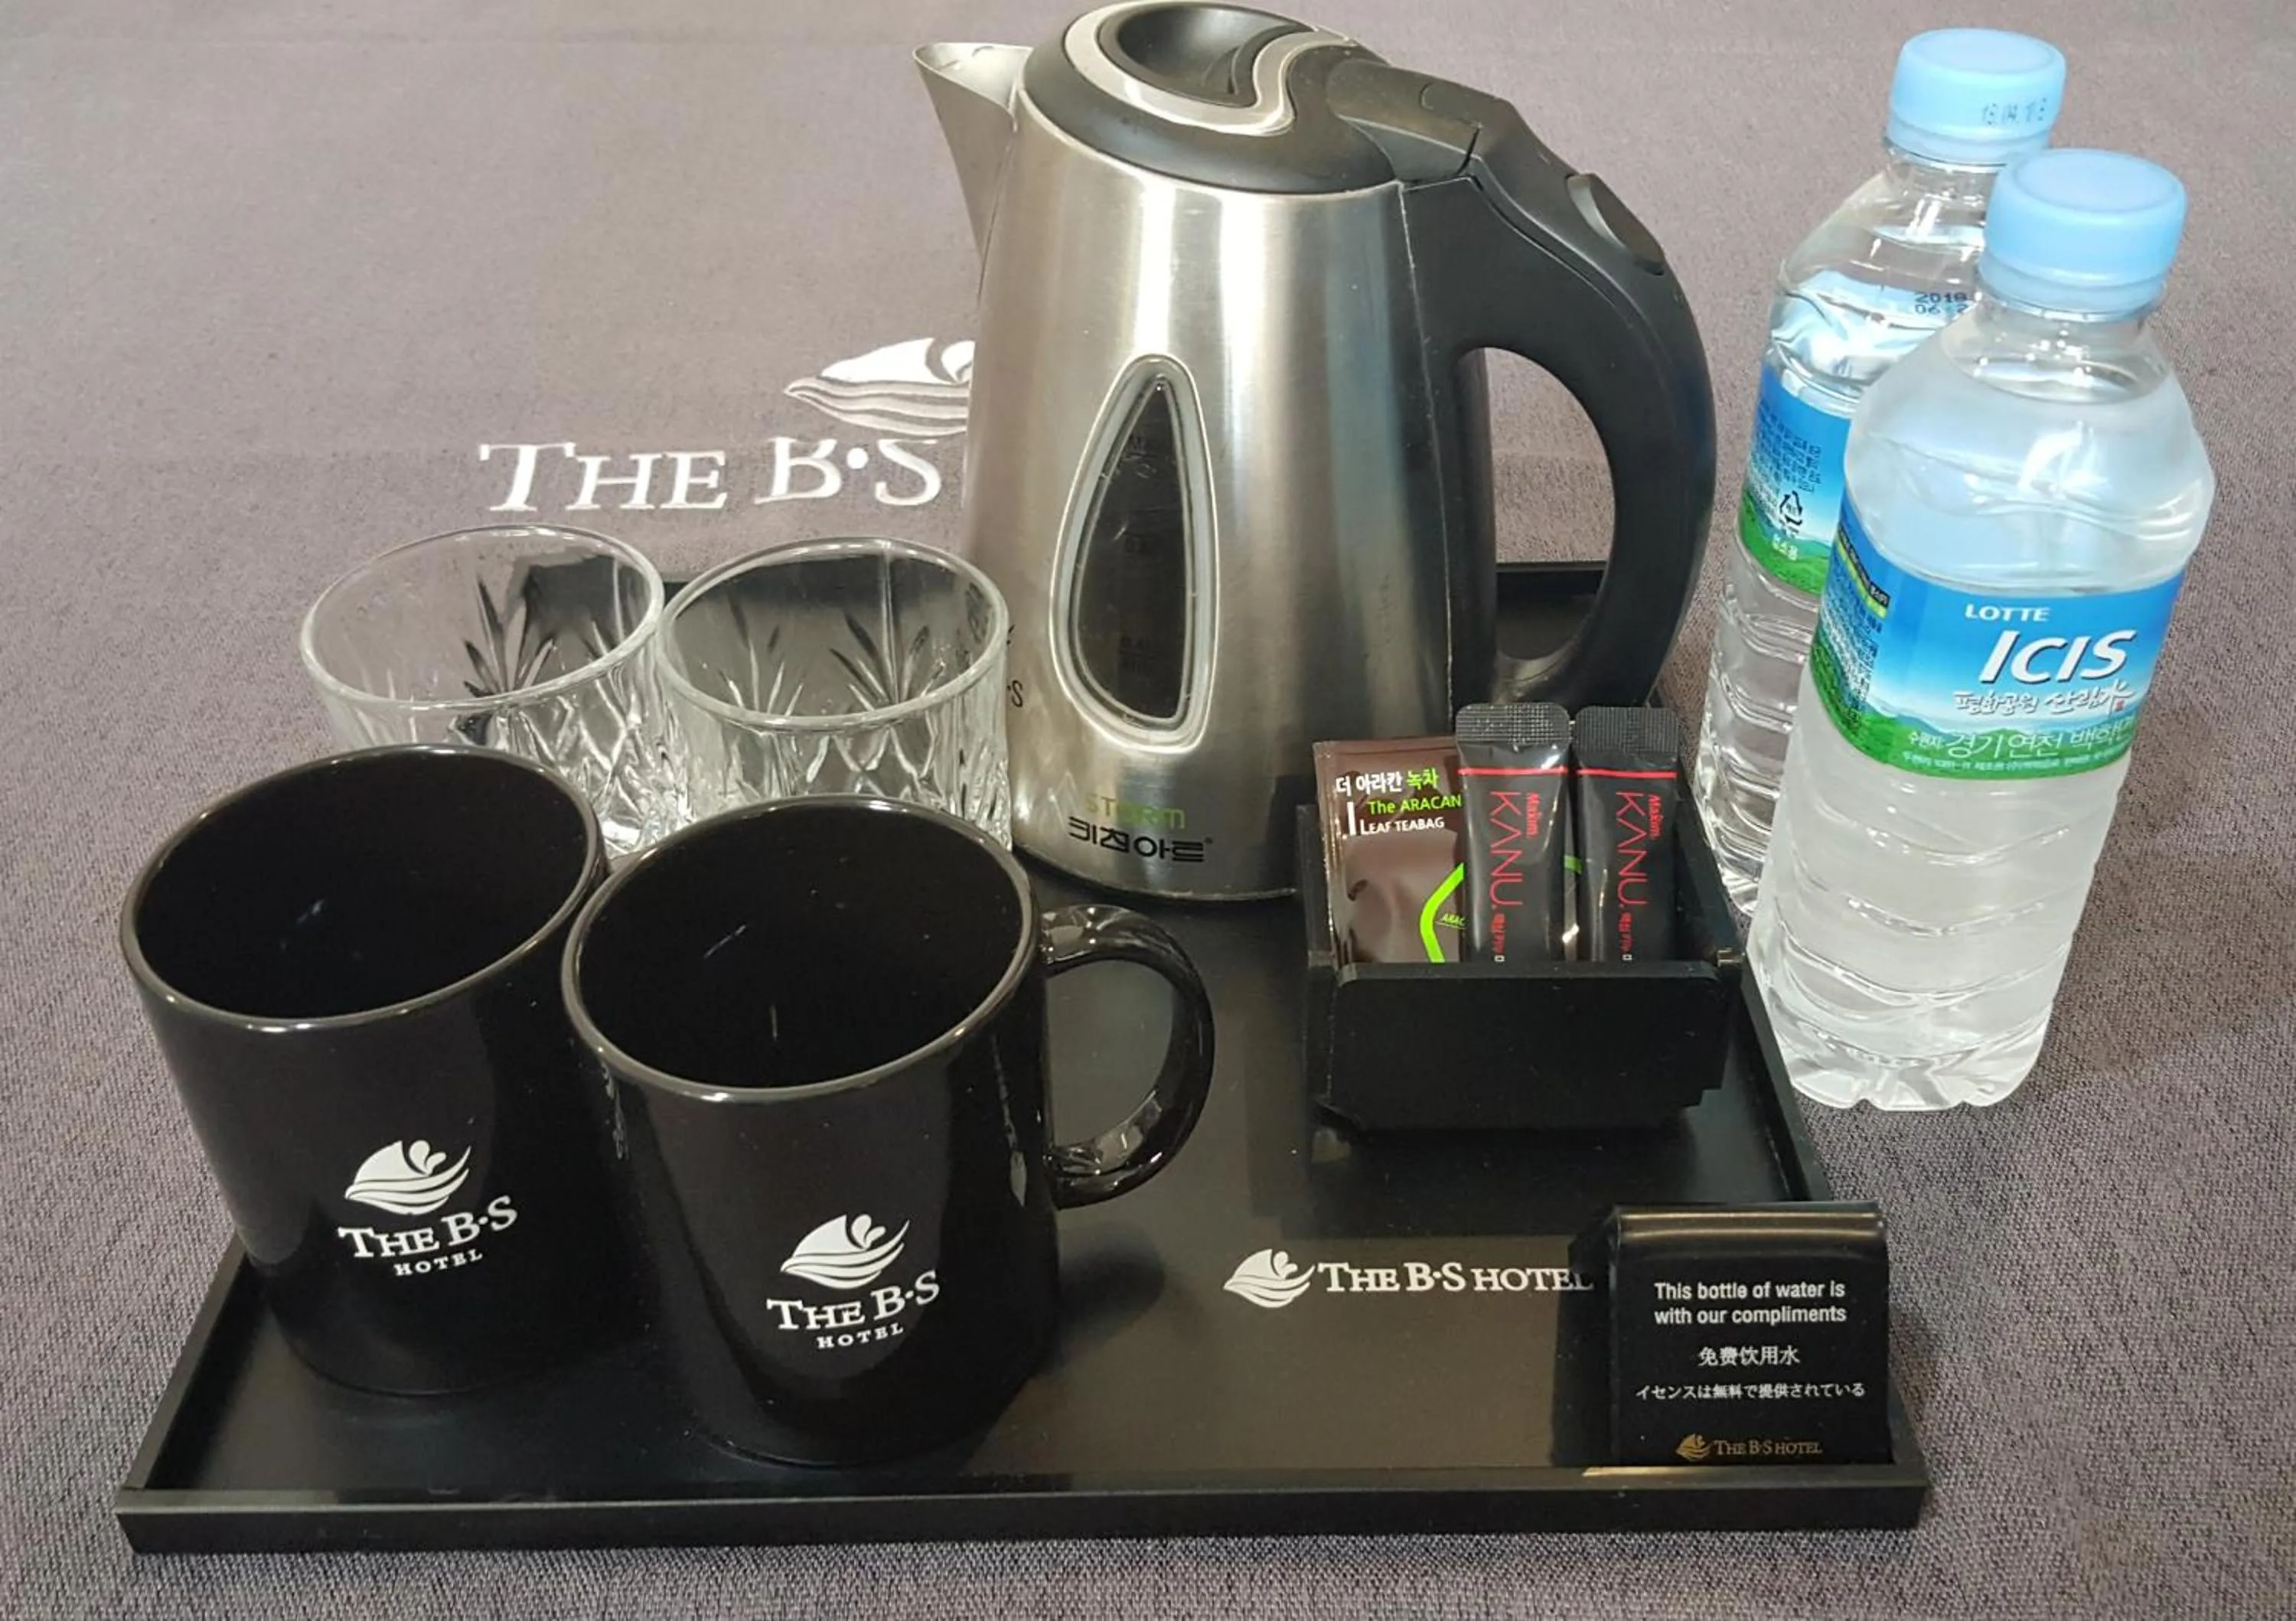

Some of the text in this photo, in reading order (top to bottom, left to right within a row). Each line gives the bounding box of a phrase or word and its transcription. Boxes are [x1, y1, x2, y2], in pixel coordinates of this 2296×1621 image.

[479, 442, 728, 512] THE
[1965, 603, 2051, 622] LOTTE
[1335, 768, 1439, 797] 더 아라칸 녹차
[1367, 794, 1463, 816] The ARACAN
[1394, 816, 1446, 833] TEABAG
[338, 1226, 440, 1258] THE
[393, 1248, 484, 1277] HOTEL
[1317, 1261, 1401, 1293] THE
[1470, 1267, 1595, 1292] HOTEL
[1653, 1280, 1846, 1300] This bottle of water is
[766, 1297, 866, 1330] THE
[1654, 1305, 1848, 1327] with our compliments
[816, 1321, 904, 1349] HOTEL
[1698, 1345, 1801, 1366] 免费饮用水
[1713, 1439, 1746, 1455] THE
[1775, 1441, 1823, 1455] HOTEL
